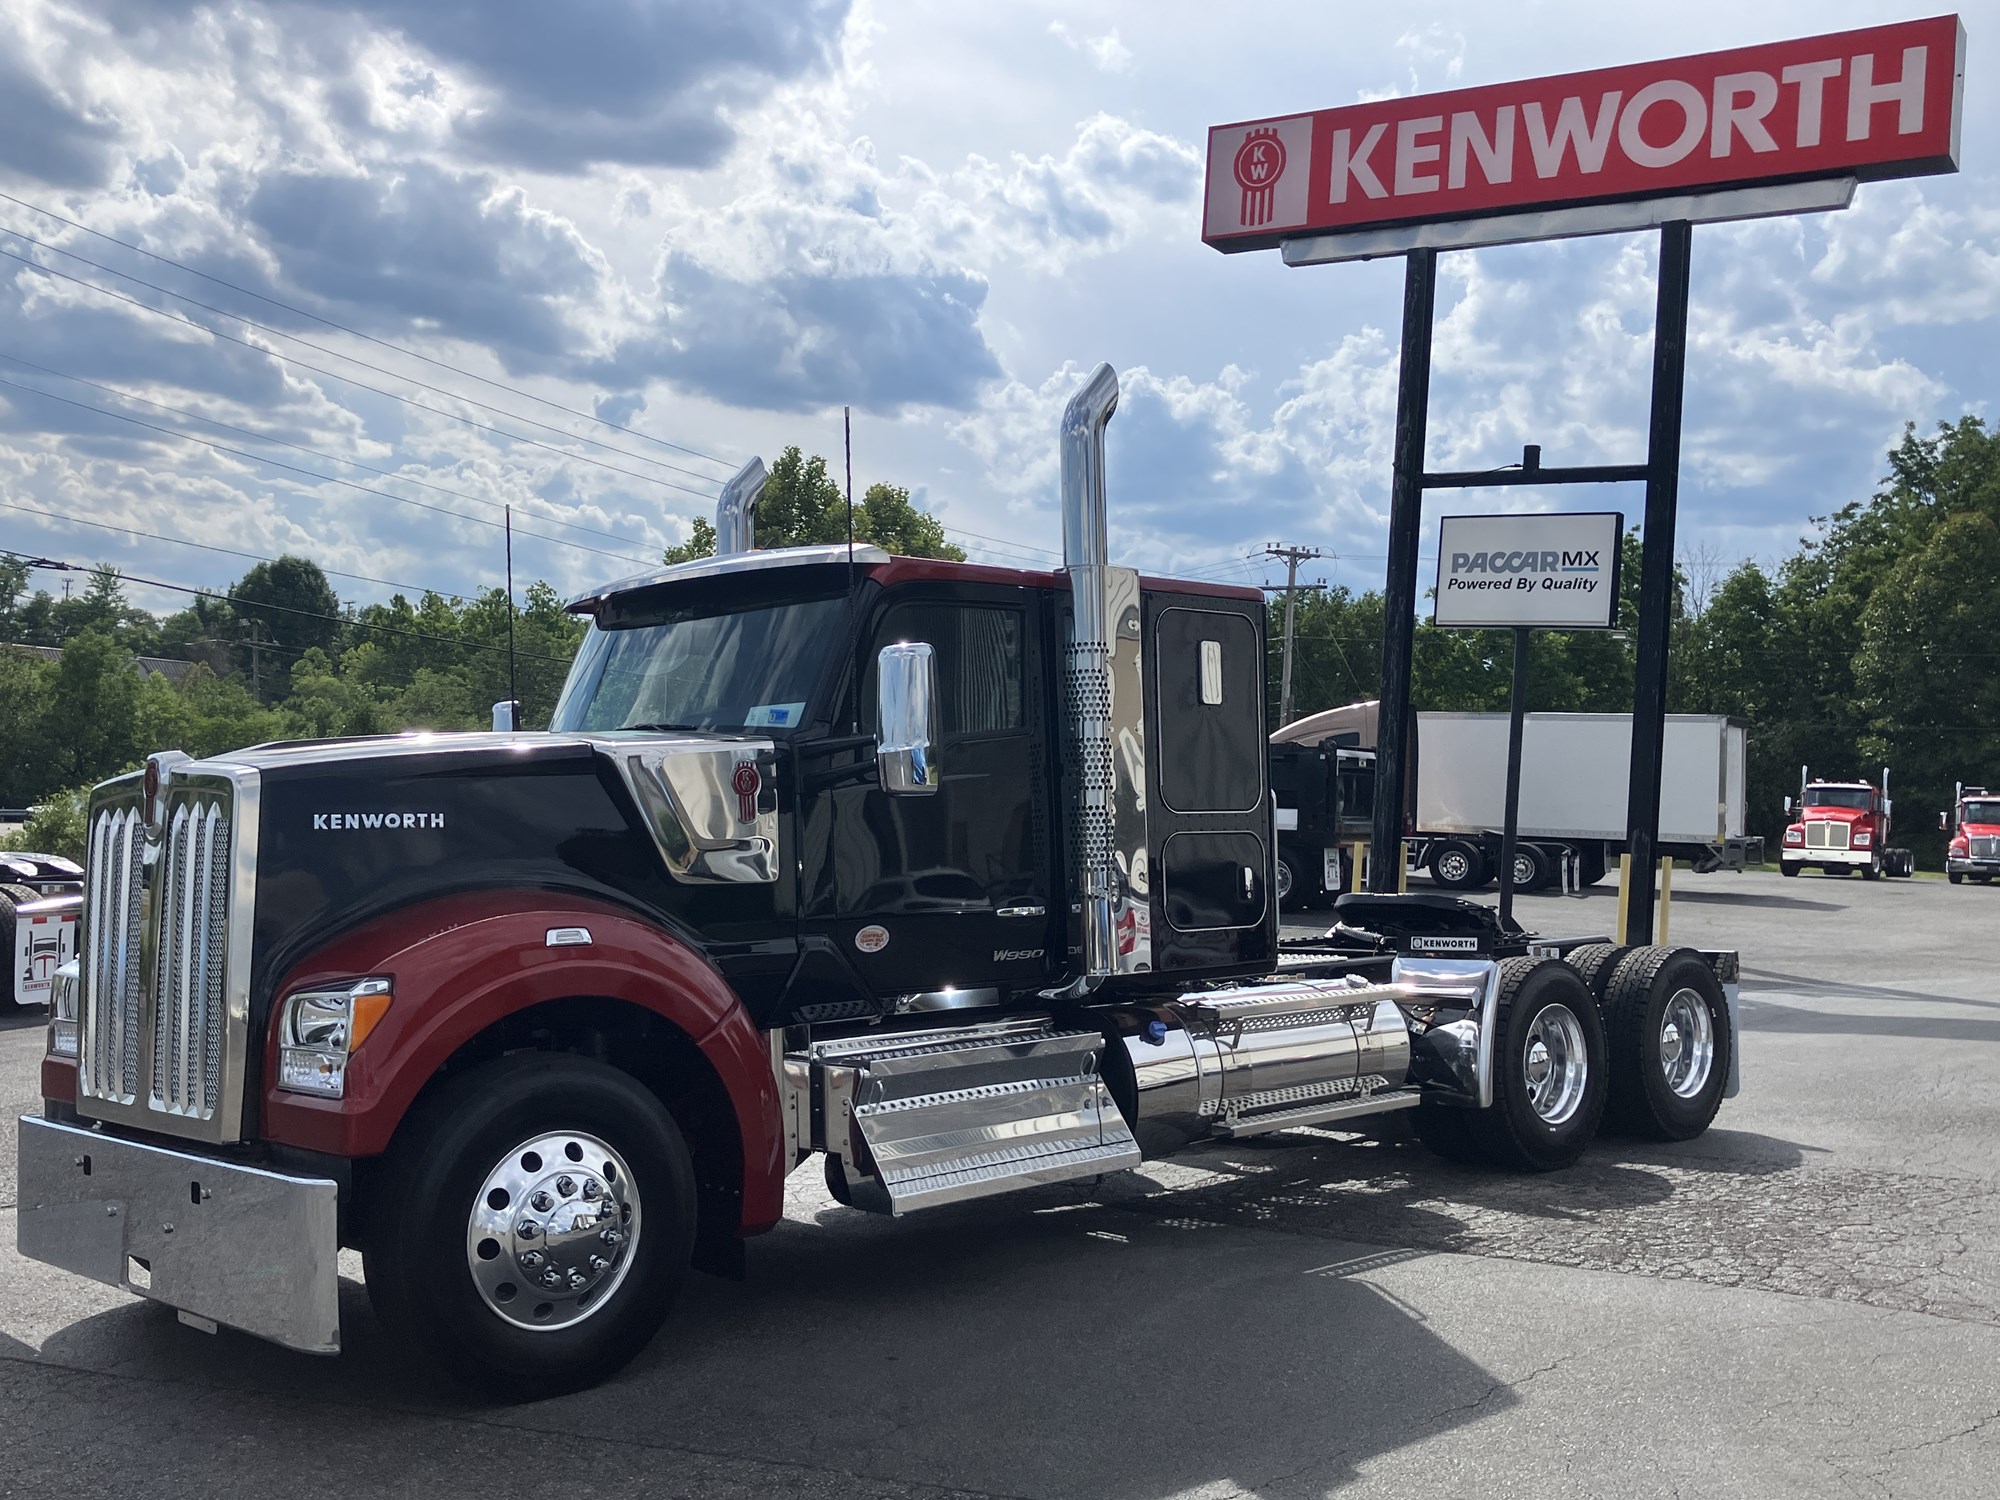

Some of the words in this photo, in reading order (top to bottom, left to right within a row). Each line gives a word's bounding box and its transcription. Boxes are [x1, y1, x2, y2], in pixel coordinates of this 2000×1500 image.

[1329, 46, 1928, 205] KENWORTH
[1447, 577, 1513, 591] Powered
[1516, 577, 1537, 593] By
[1541, 577, 1599, 593] Quality
[313, 812, 445, 830] KENWORTH
[1423, 939, 1476, 949] KENWORTH
[993, 949, 1045, 962] W990
